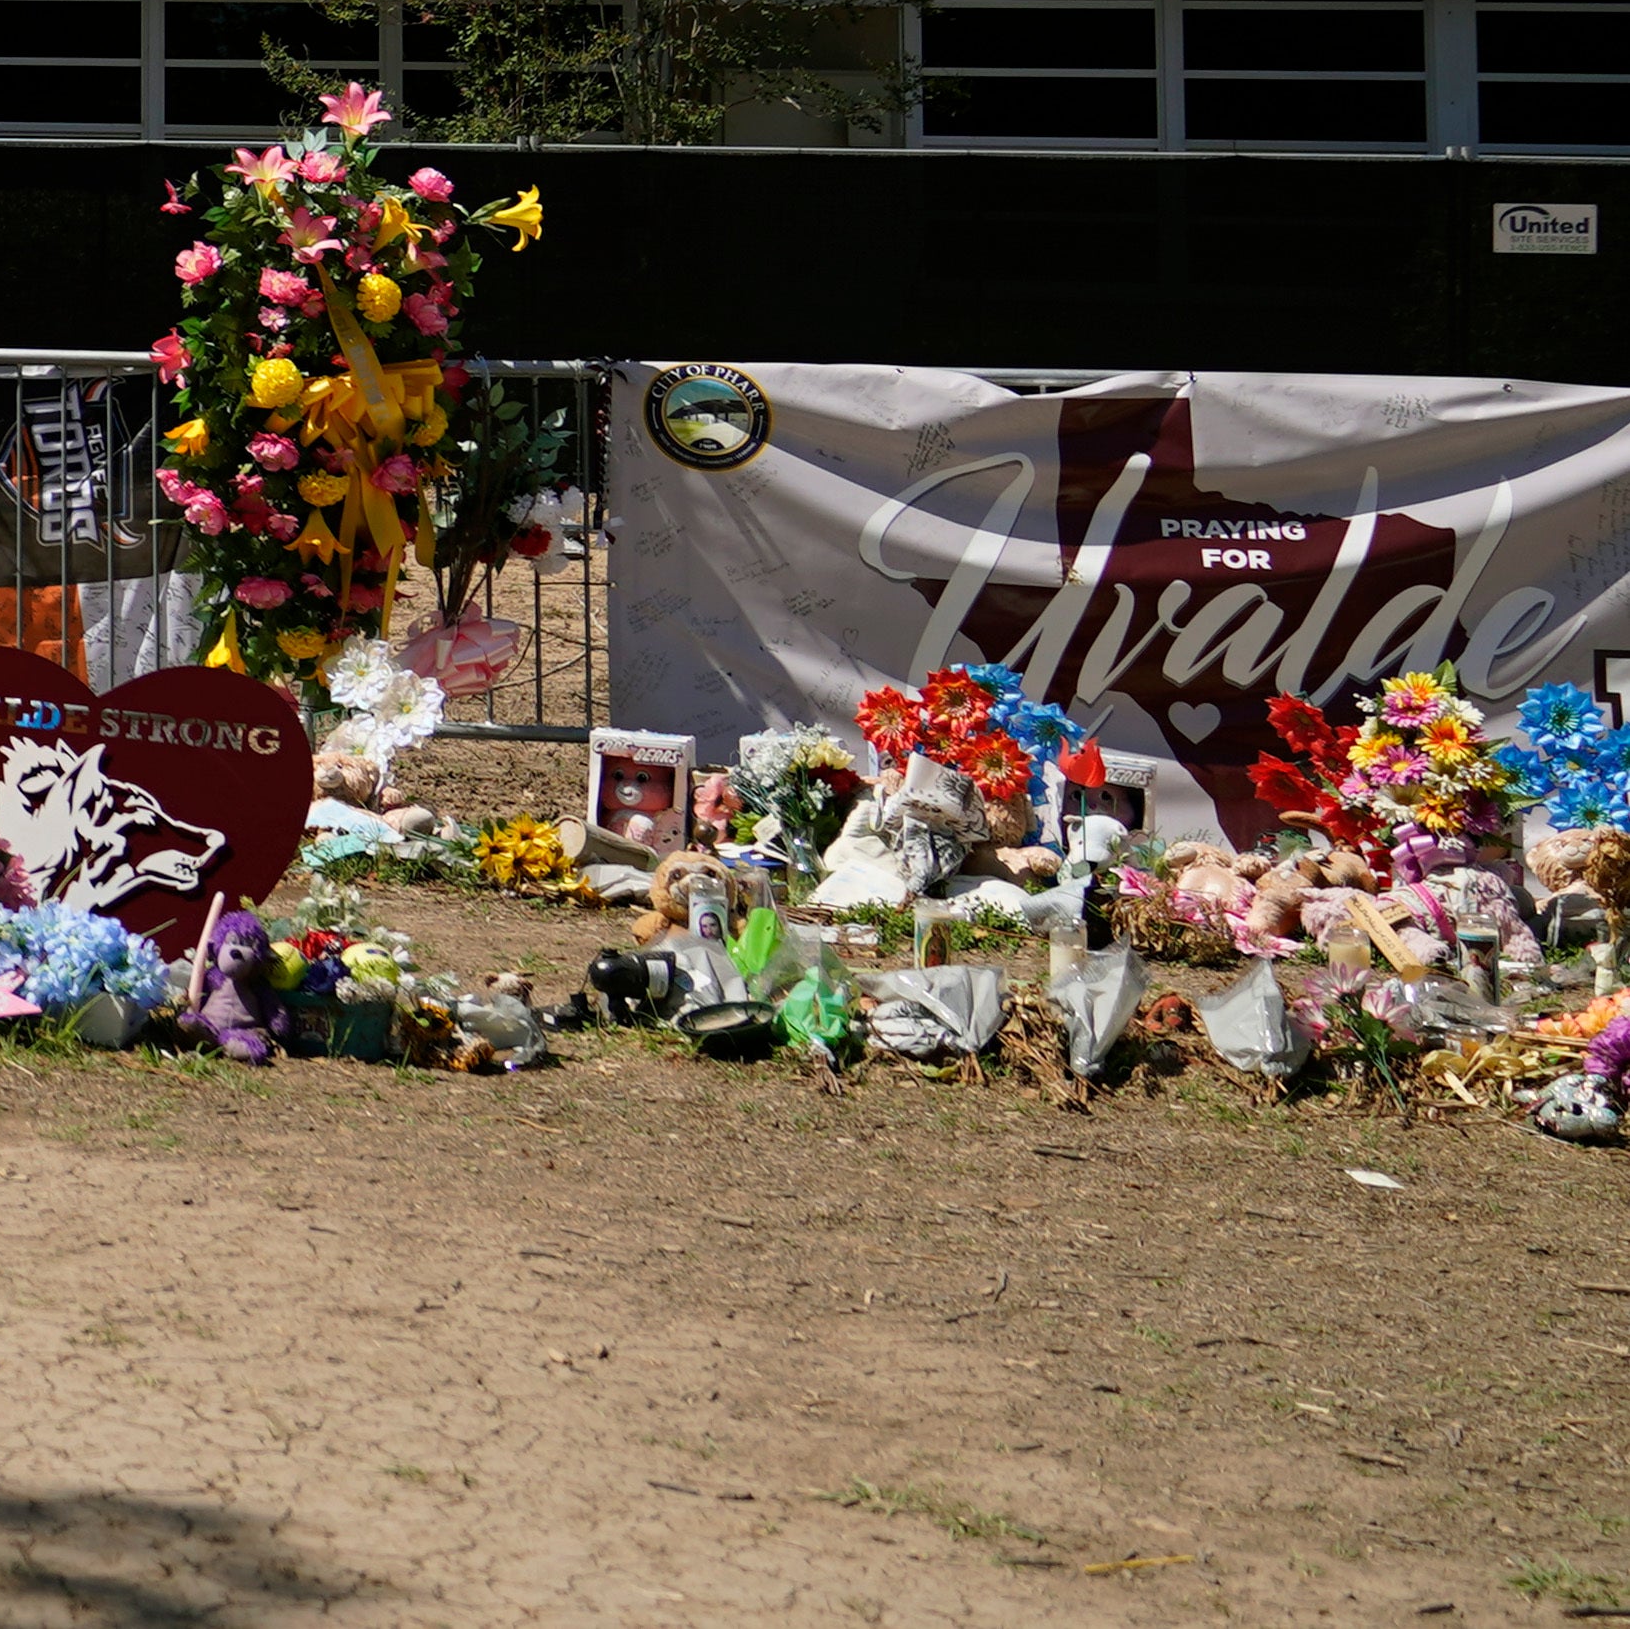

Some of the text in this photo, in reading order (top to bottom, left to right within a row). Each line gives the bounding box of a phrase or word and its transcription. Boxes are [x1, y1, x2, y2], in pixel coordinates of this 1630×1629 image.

[1509, 216, 1590, 234] United
[651, 364, 765, 412] CITY OF PHARR
[1160, 519, 1306, 542] PRAYING
[1201, 548, 1272, 571] FOR
[858, 450, 1588, 720] Uvalde
[98, 707, 281, 755] STRONG
